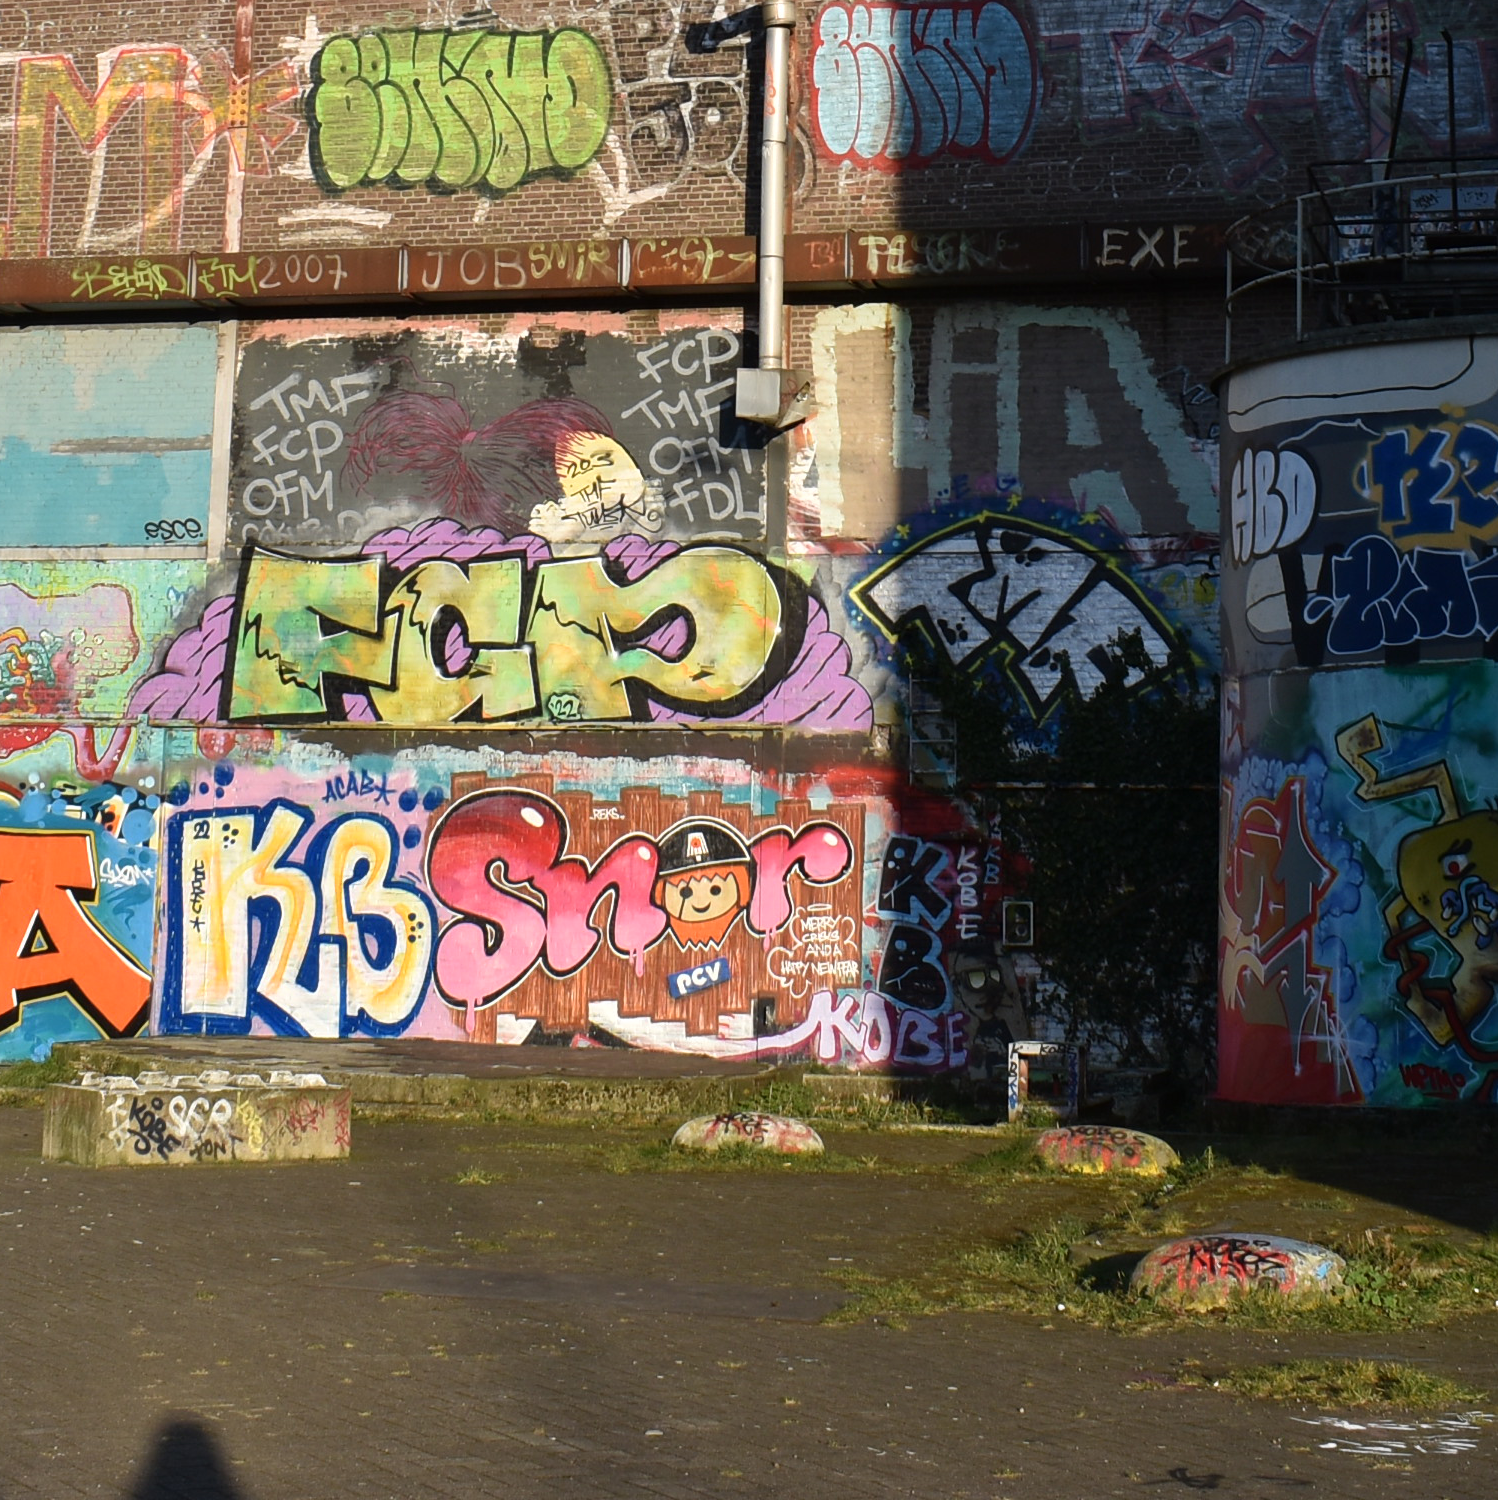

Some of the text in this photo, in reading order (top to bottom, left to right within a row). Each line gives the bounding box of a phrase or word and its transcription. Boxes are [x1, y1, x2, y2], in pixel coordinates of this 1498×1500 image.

[257, 253, 348, 291] 2007
[420, 246, 527, 290] JOB
[636, 328, 740, 384] FCP
[250, 370, 381, 424] TMF
[620, 376, 736, 434] TMF
[252, 420, 344, 467] FCP
[242, 470, 334, 518] OFM
[669, 466, 766, 523] FDL
[956, 845, 981, 940] KOBE
[800, 915, 842, 933] MERRY
[780, 960, 810, 978] HAPPY
[799, 988, 969, 1068] KOBE
